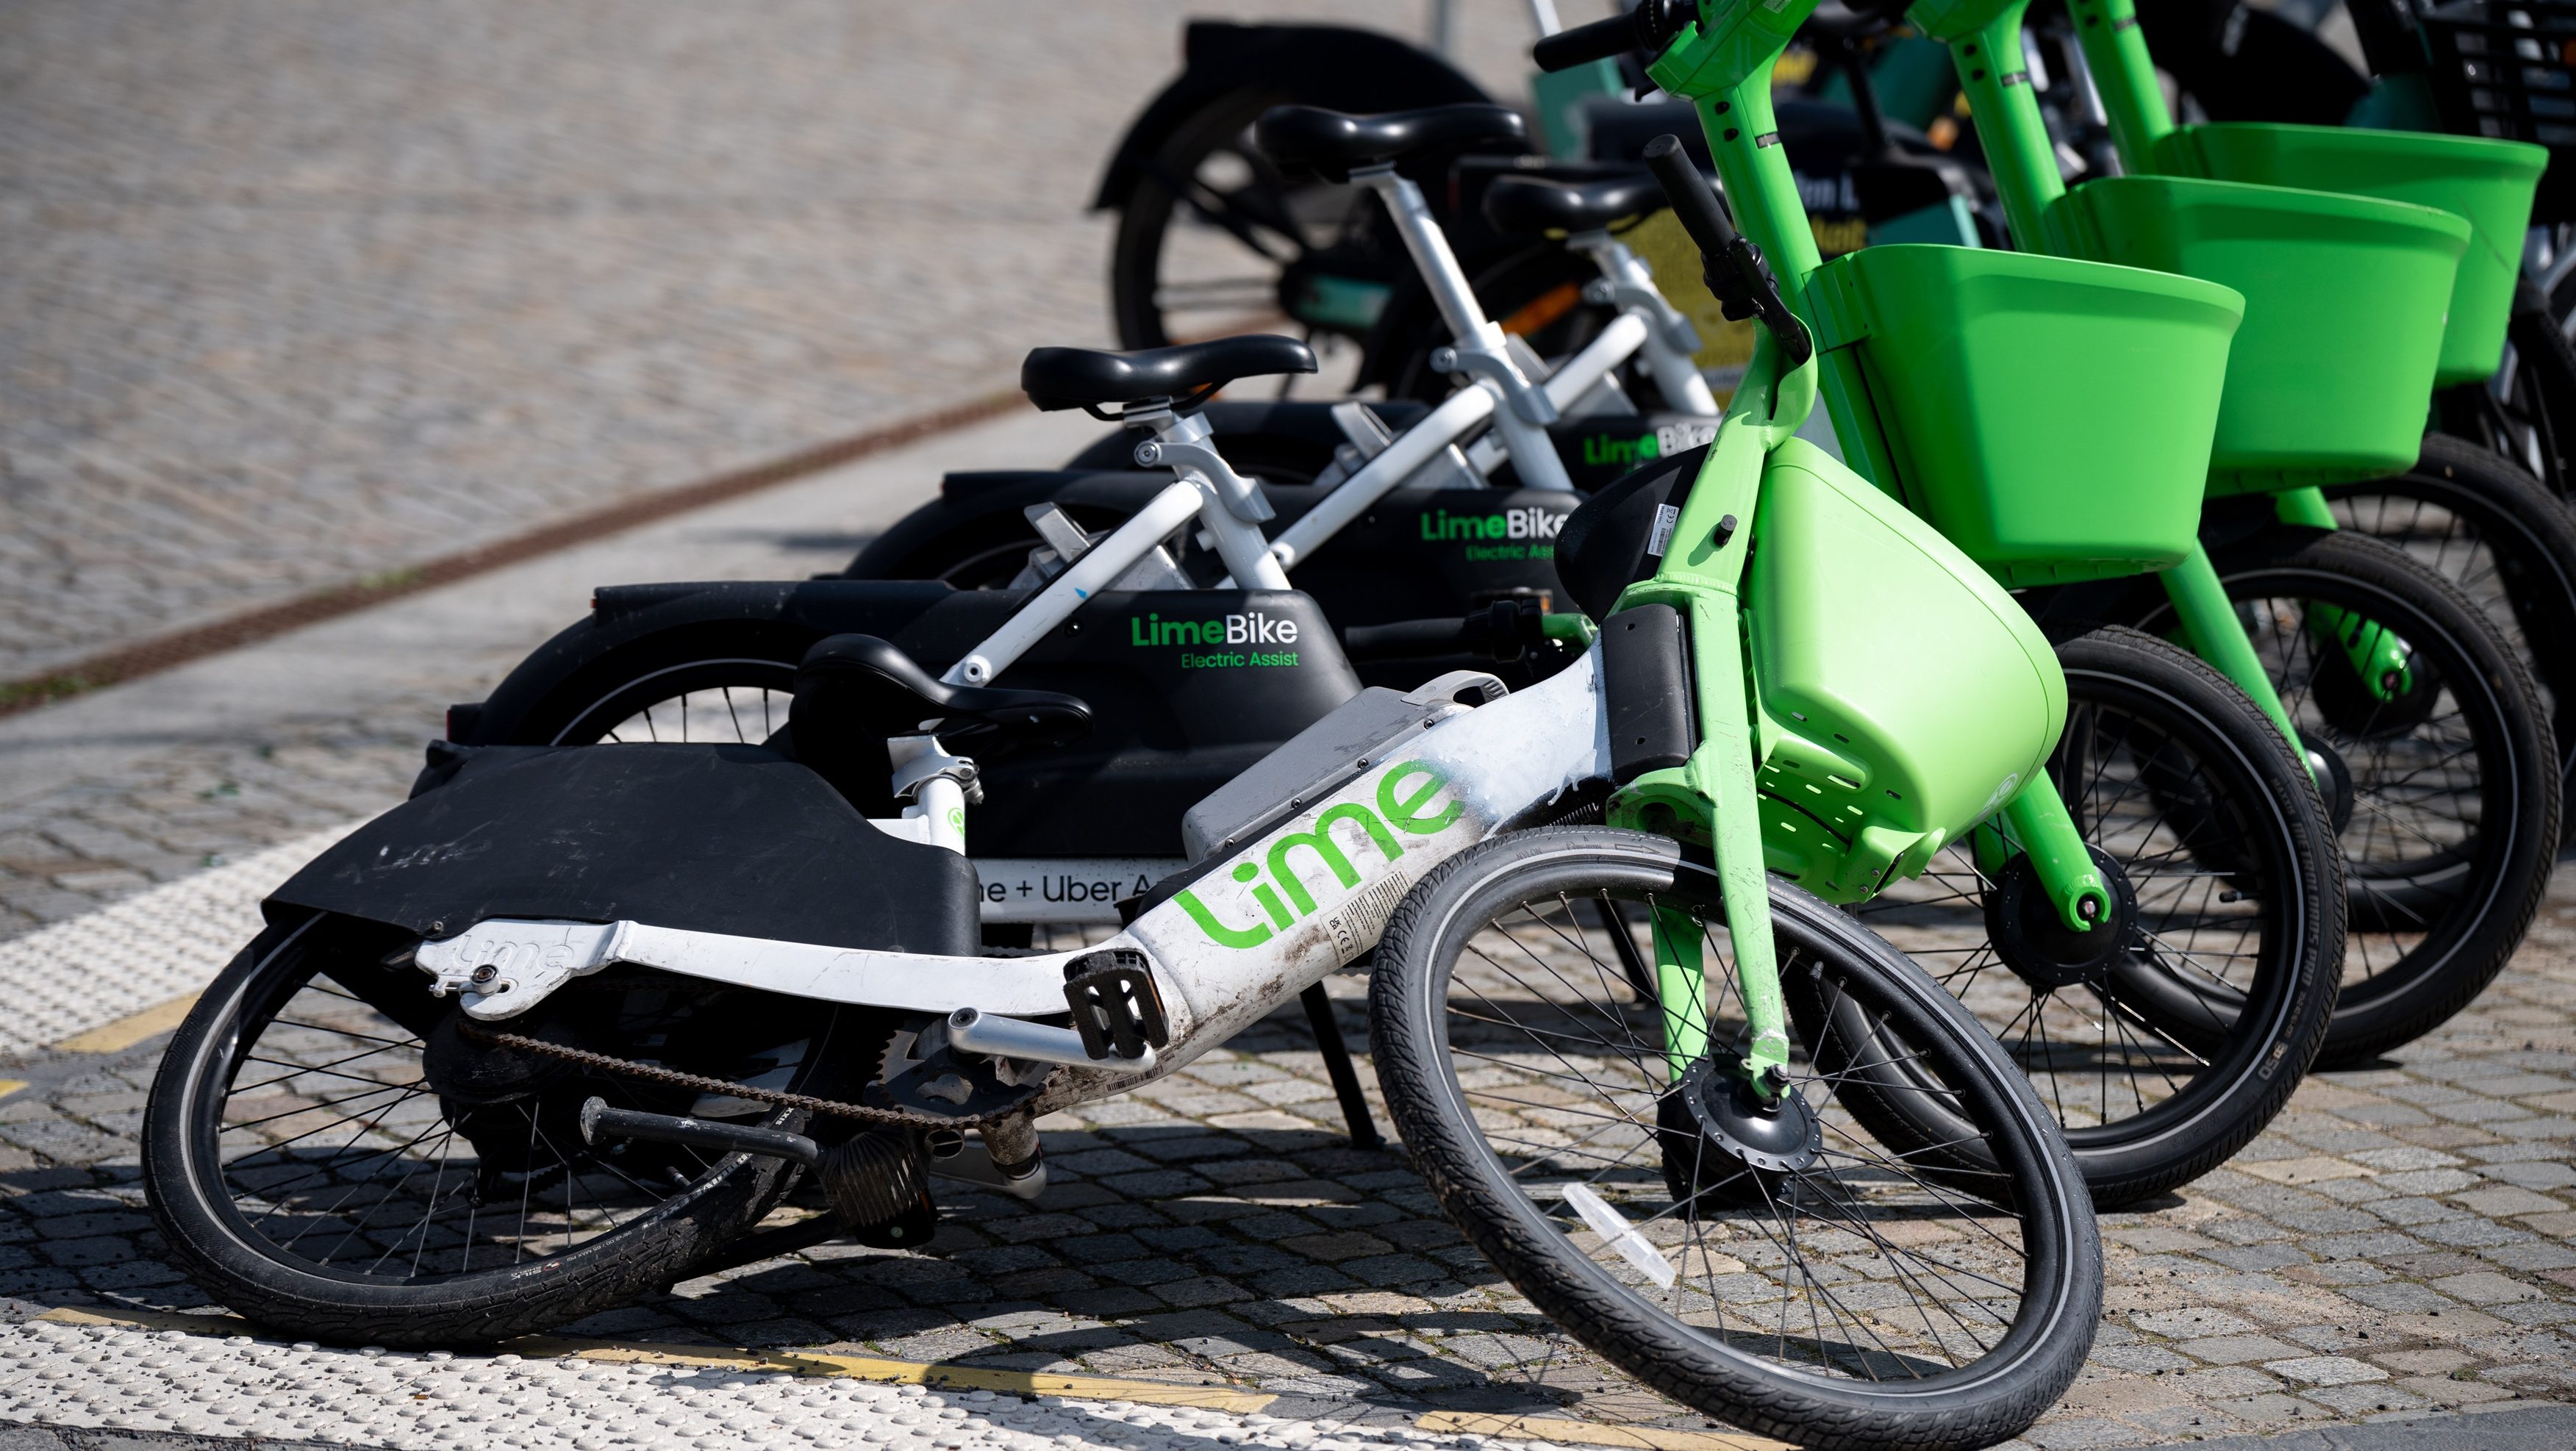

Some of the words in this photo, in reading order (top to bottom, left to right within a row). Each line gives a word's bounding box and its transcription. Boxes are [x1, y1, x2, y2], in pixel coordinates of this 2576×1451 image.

[1131, 612, 1298, 646] LimeBike
[1181, 652, 1245, 668] Electric
[1250, 651, 1299, 667] Assist
[1173, 759, 1466, 949] Lime
[979, 883, 1006, 903] e
[1016, 881, 1033, 898] +
[1042, 875, 1122, 903] Uber
[577, 1249, 592, 1257] MAX
